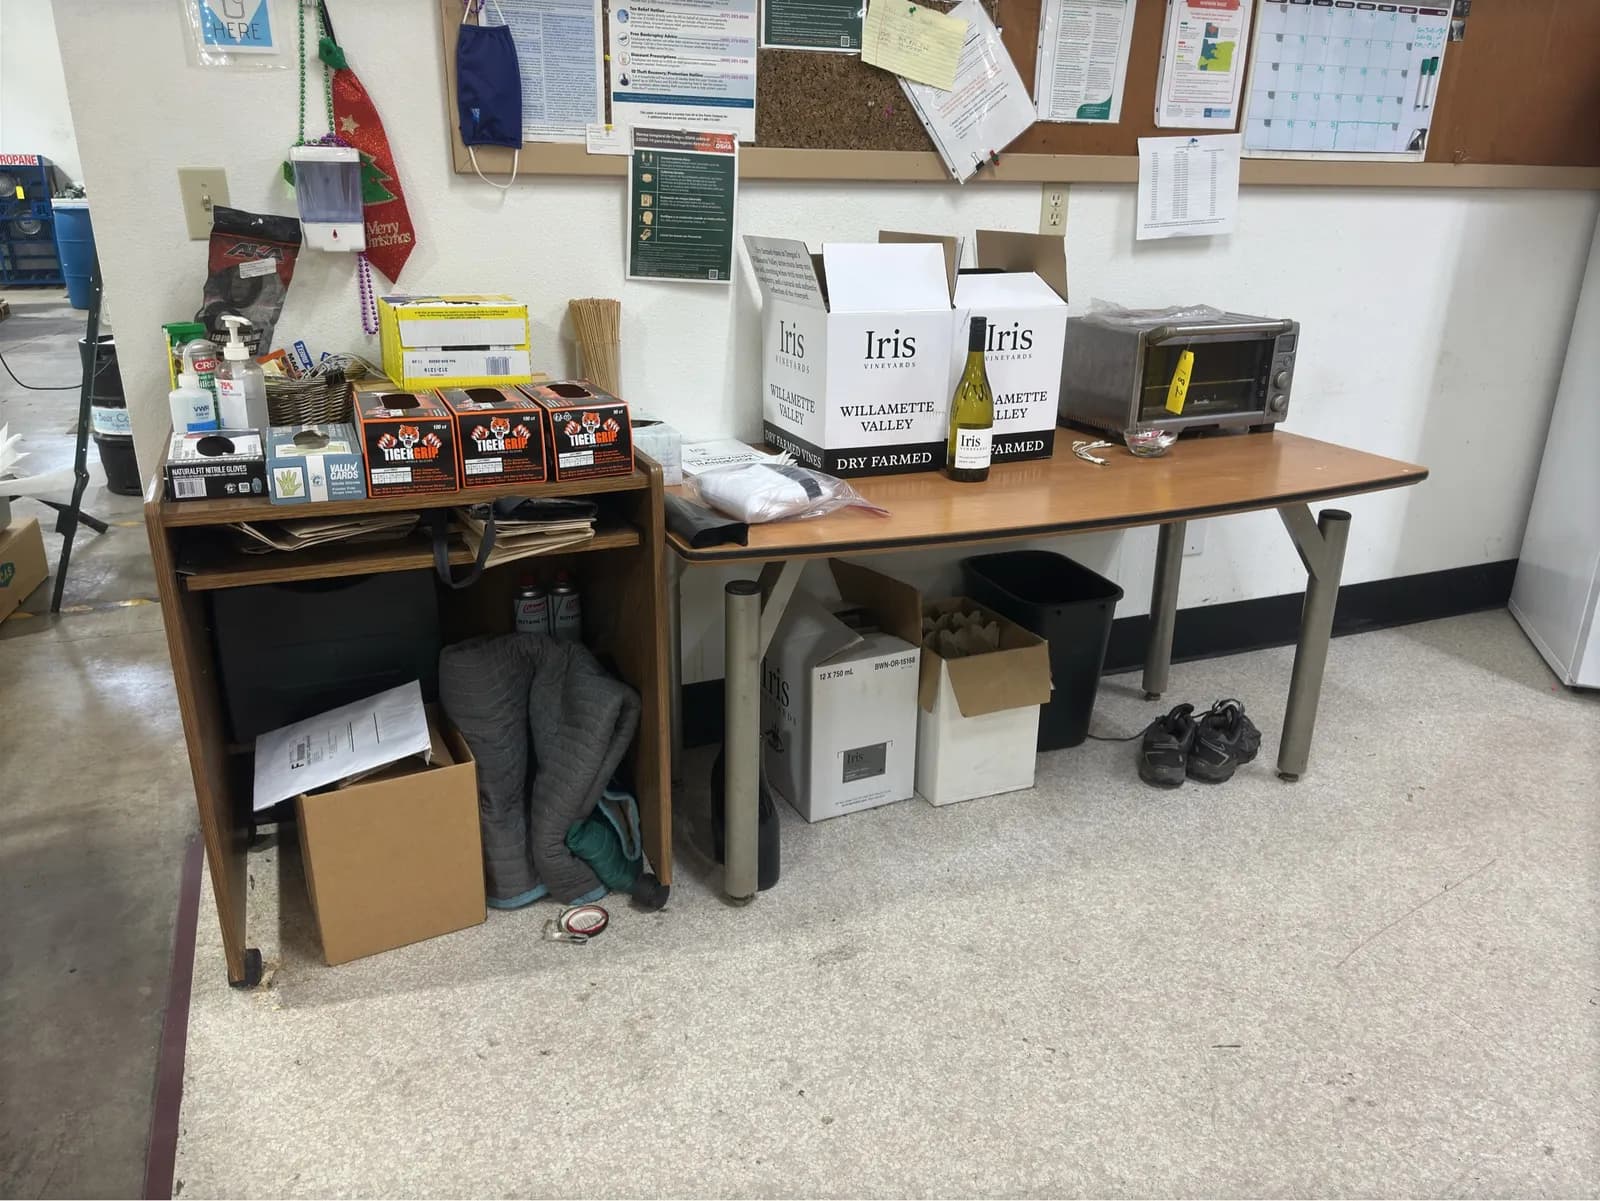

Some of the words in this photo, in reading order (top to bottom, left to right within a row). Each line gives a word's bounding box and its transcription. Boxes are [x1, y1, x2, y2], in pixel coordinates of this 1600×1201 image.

[213, 22, 262, 40] HERE
[0, 154, 36, 165] ROPANE
[366, 220, 399, 234] Merry
[366, 232, 412, 248] hristmas
[780, 320, 805, 358] Iris
[864, 328, 916, 359] Iris
[986, 322, 1033, 352] Iris
[775, 354, 810, 374] VINEYARDS
[770, 383, 816, 413] WILLAMETTE
[993, 391, 1048, 405] AMETTE
[779, 403, 805, 425] VALLEY
[840, 401, 935, 417] WILLAMETTE
[993, 408, 1028, 420] LLEY
[861, 418, 914, 432] VALLEY
[765, 429, 777, 444] DRY
[777, 435, 800, 456] FARMED
[802, 448, 822, 469] VINES
[960, 434, 981, 448] Iris
[330, 464, 349, 472] VALU
[836, 457, 867, 470] DRY
[872, 452, 932, 468] FARMED
[172, 466, 204, 476] NATURALFIT
[330, 470, 358, 480] GARDS
[761, 656, 790, 707] Iris
[833, 670, 844, 678] 750
[847, 752, 864, 764] Iris
